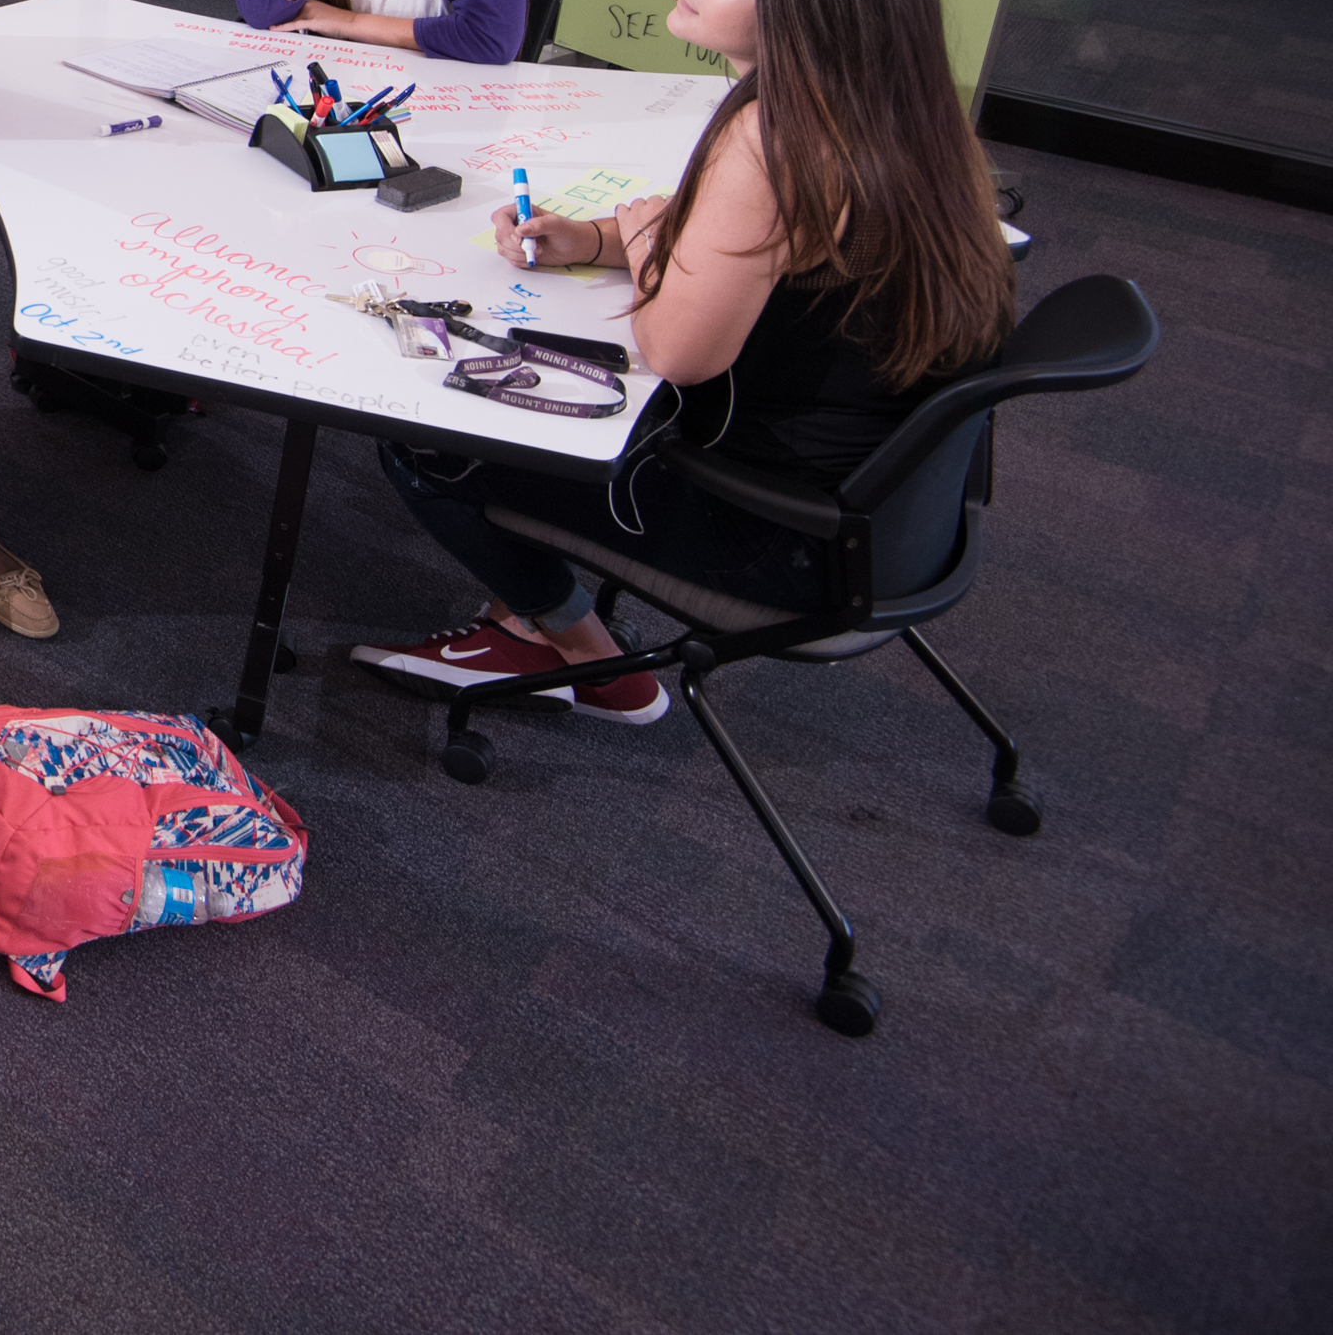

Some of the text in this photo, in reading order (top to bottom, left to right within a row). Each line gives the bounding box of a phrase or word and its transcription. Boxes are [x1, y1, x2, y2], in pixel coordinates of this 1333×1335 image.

[608, 4, 659, 39] SEE
[71, 330, 144, 355] 2nd
[464, 360, 493, 371] UNION
[534, 350, 608, 382] MOUNT UNION
[292, 379, 422, 418] people!
[500, 392, 581, 414] MOUNT UNION
